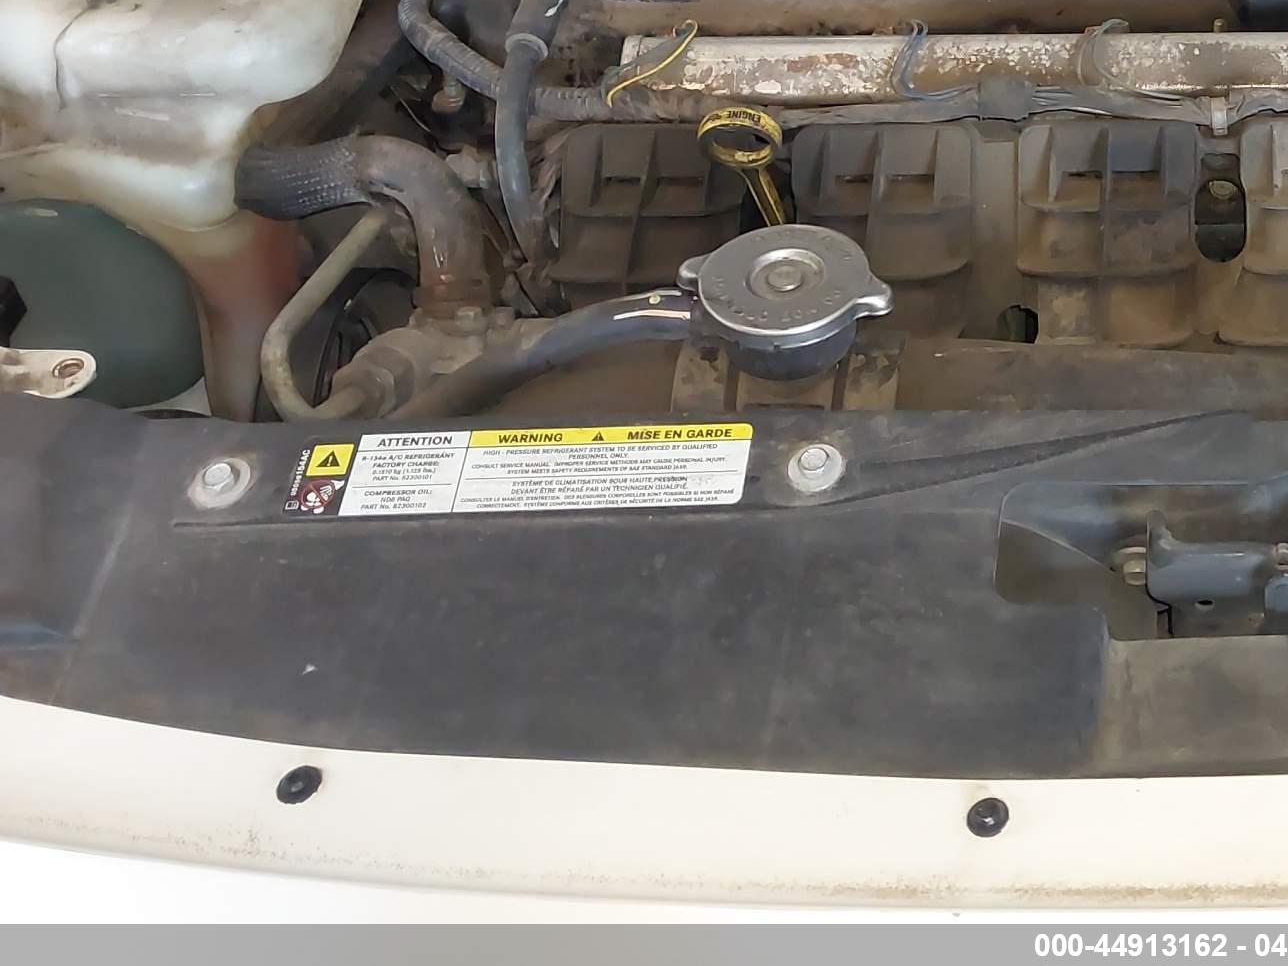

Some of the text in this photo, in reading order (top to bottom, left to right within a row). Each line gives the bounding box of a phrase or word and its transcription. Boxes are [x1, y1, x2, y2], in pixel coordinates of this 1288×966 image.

[726, 111, 761, 123] ENGINE
[498, 433, 563, 444] WARNING
[627, 428, 733, 440] MISE EN GARDE
[377, 436, 453, 448] ATTENTION
[405, 452, 455, 460] REFRIGERANT
[542, 447, 587, 455] REFRIGERANT
